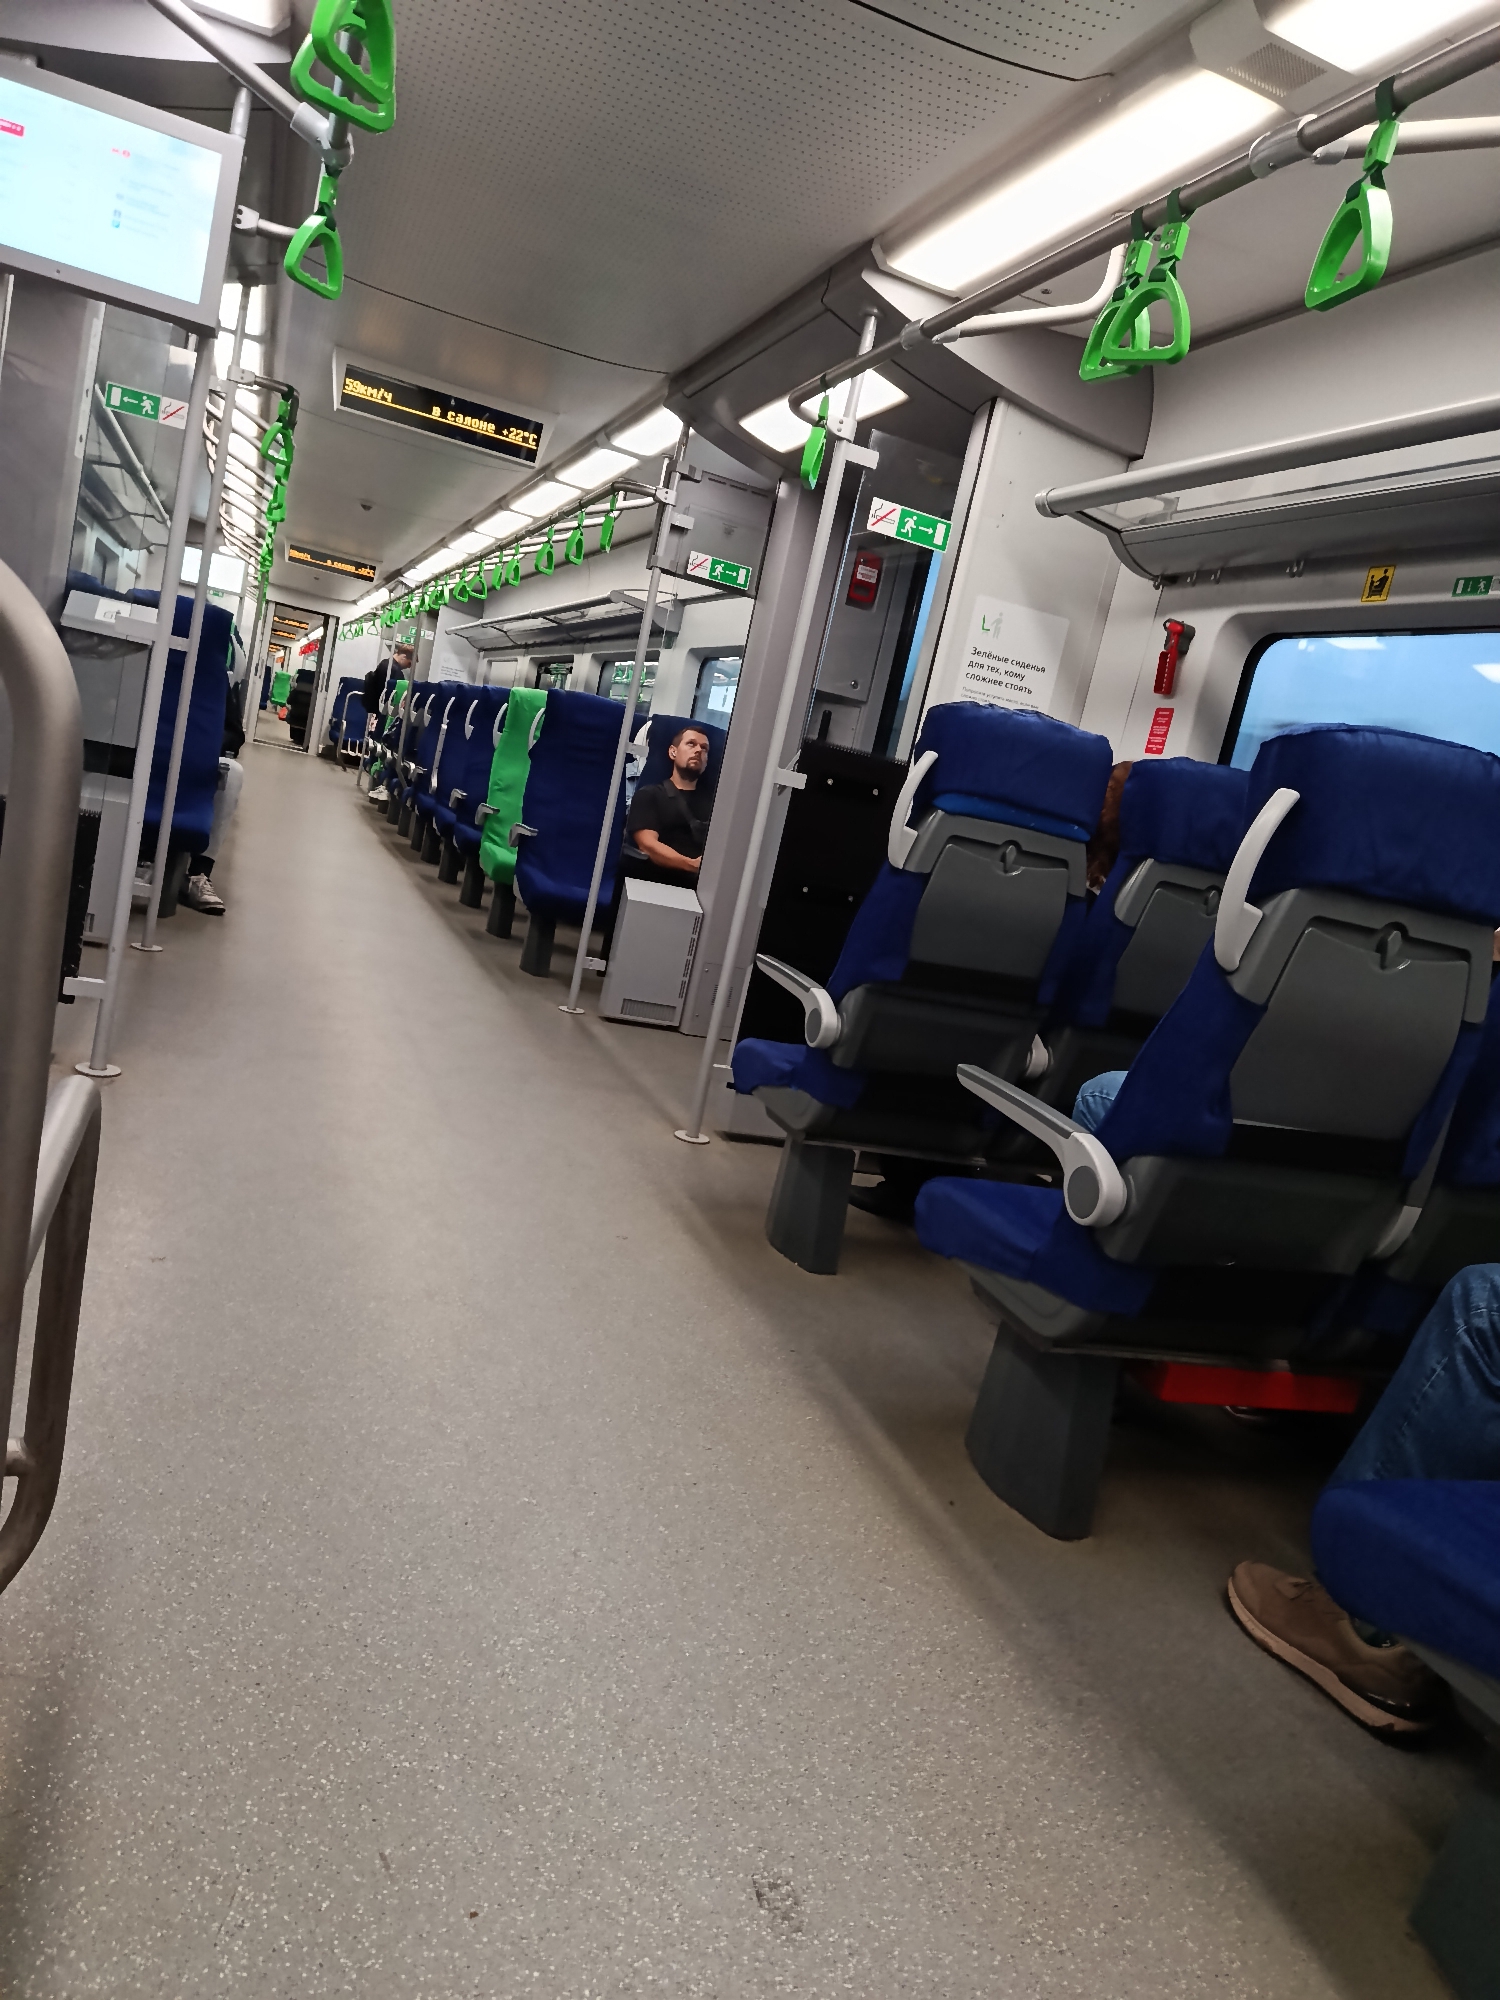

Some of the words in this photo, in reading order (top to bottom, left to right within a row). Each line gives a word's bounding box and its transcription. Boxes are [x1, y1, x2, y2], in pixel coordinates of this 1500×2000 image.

[447, 409, 496, 434] салоне
[971, 646, 1009, 664] Зелёные
[1010, 658, 1046, 674] сиденья
[965, 672, 1003, 687] сложнее
[1004, 682, 1033, 695] стоять
[986, 665, 1002, 676] тех,
[1004, 670, 1026, 682] кому
